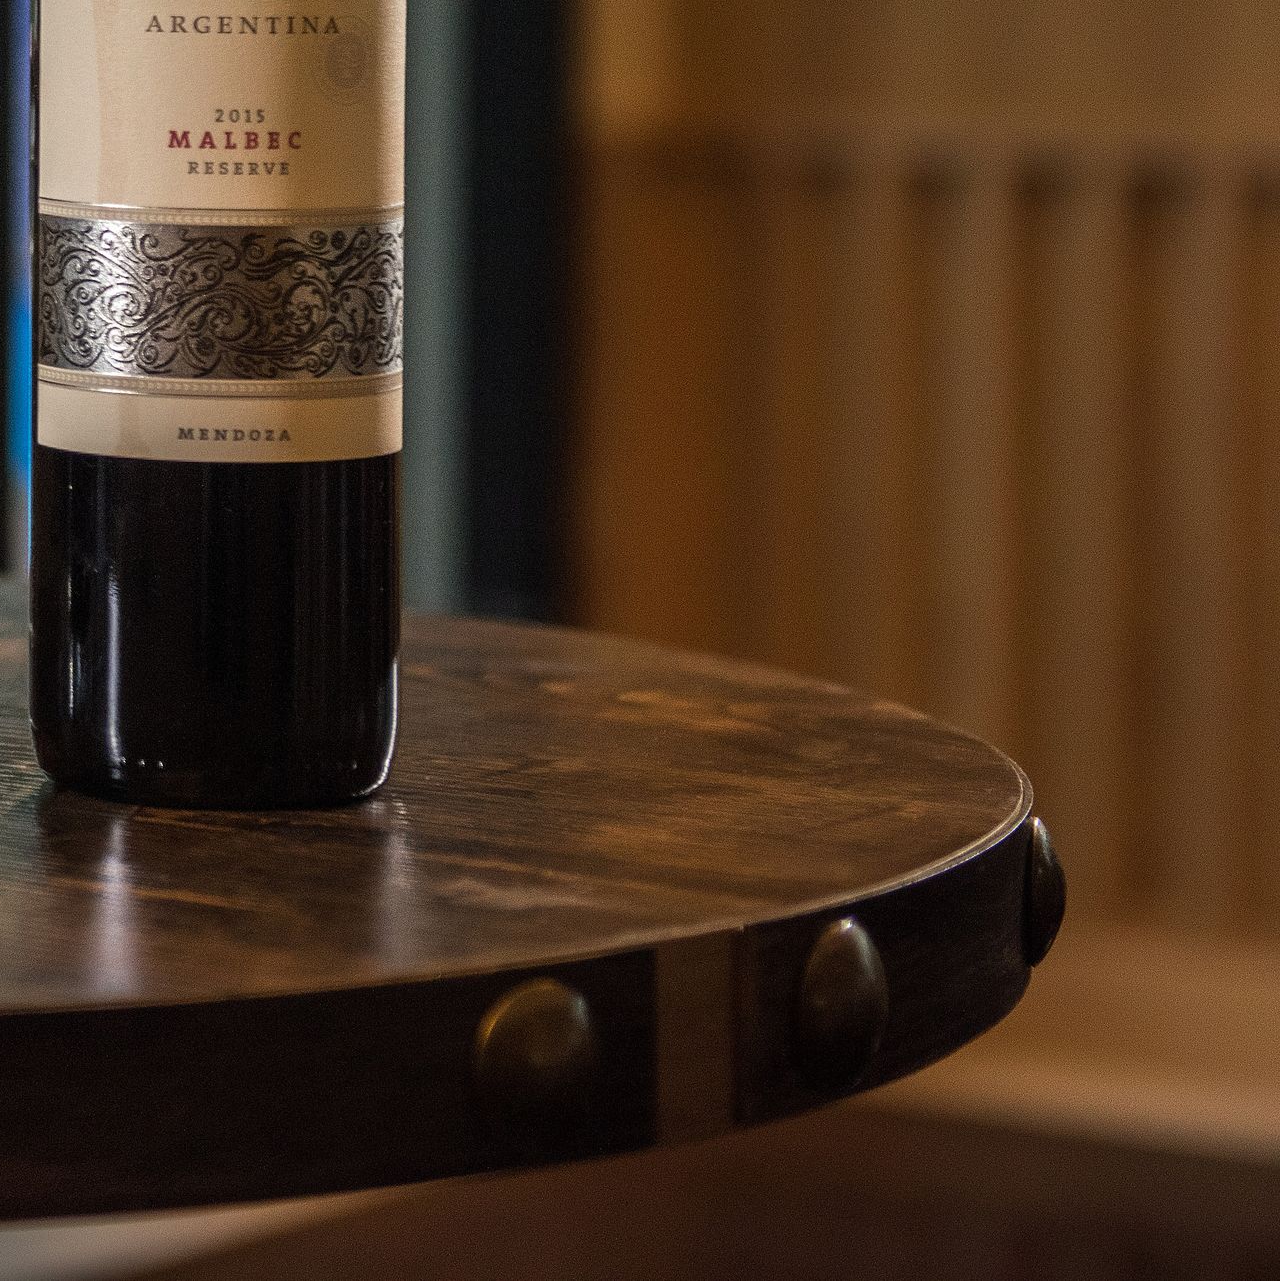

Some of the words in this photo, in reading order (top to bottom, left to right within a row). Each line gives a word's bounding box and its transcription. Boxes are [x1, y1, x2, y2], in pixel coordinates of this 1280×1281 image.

[145, 15, 340, 35] ARGENTINA
[214, 108, 267, 124] 2015
[167, 130, 303, 150] MALBEC
[186, 161, 291, 176] RESERVE
[177, 427, 292, 443] MENDOZA
